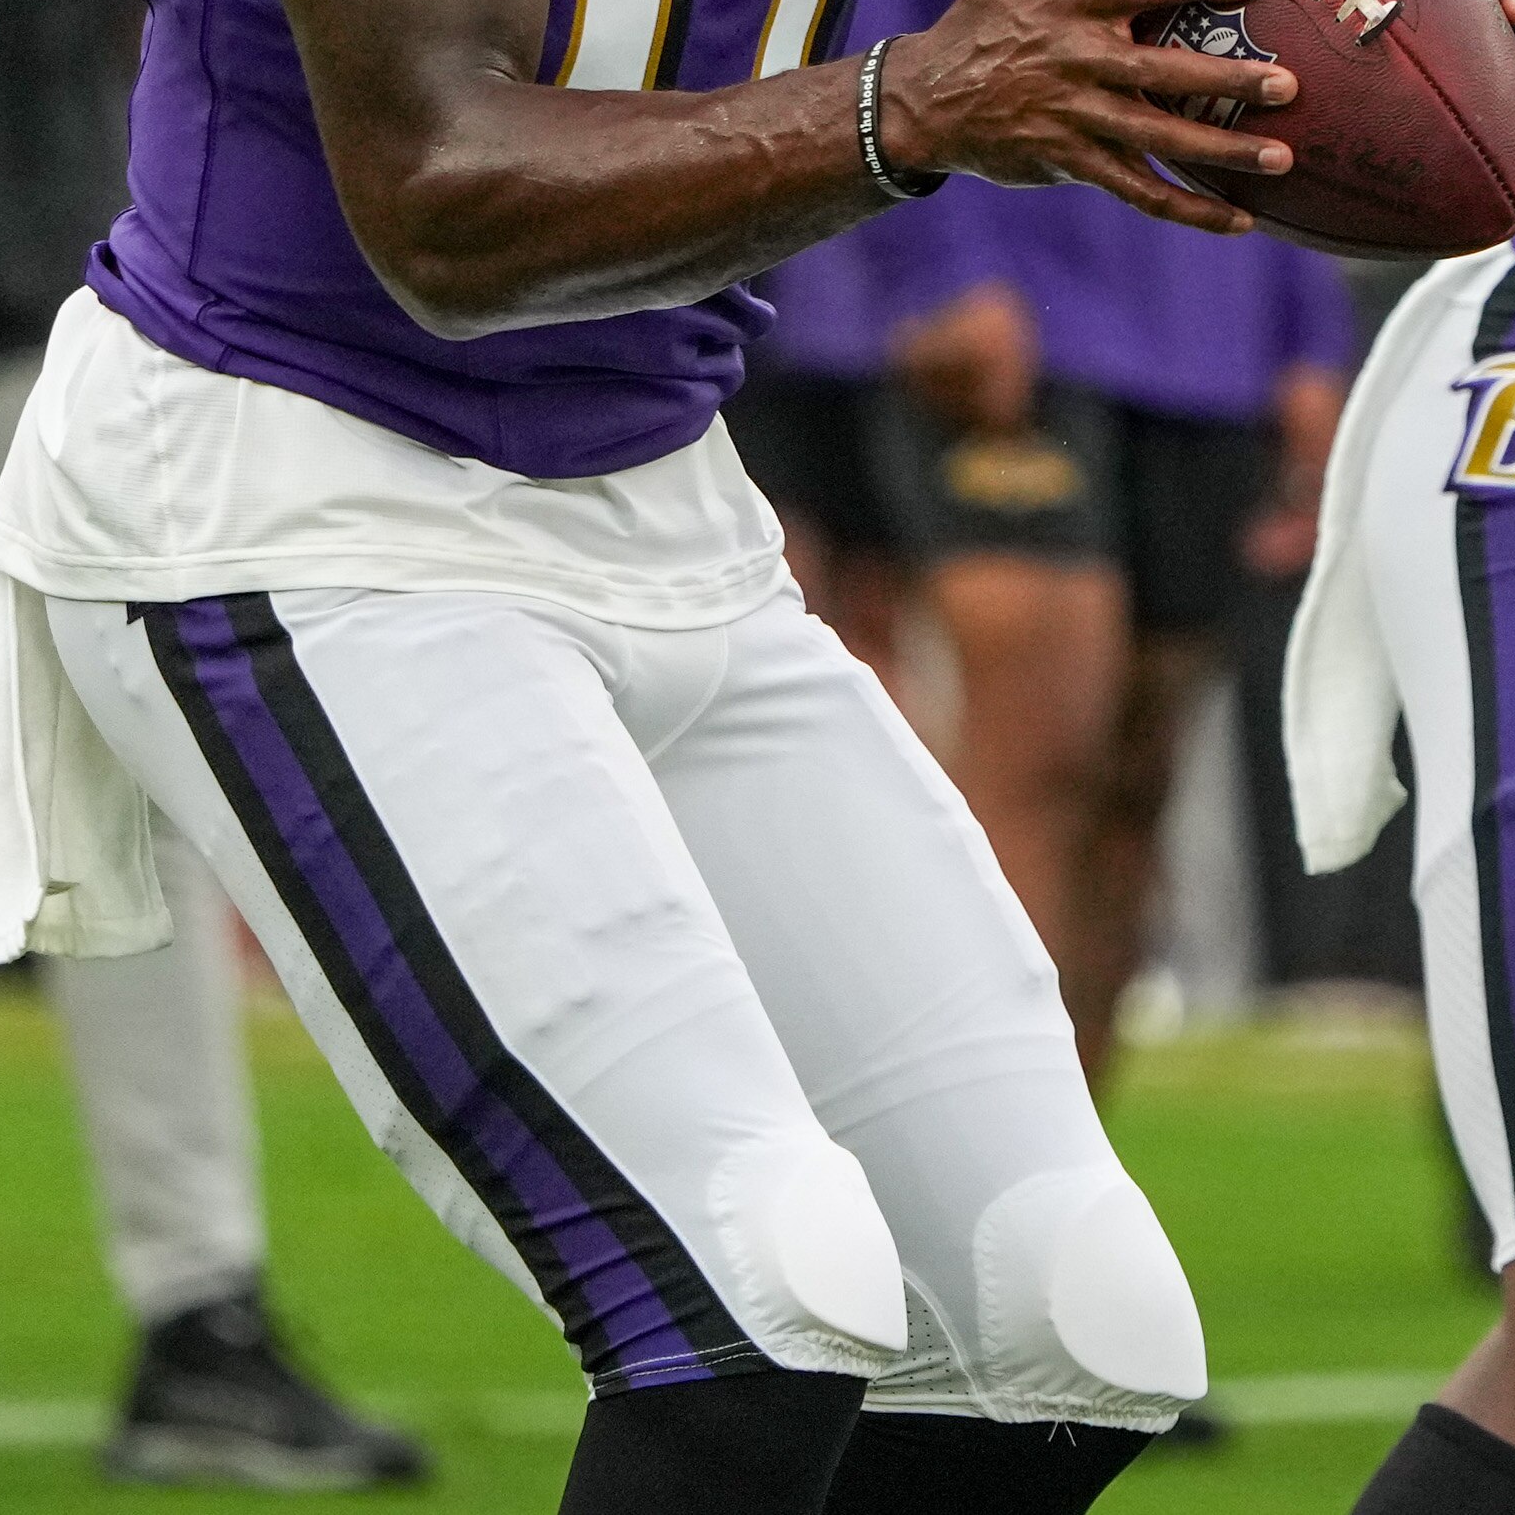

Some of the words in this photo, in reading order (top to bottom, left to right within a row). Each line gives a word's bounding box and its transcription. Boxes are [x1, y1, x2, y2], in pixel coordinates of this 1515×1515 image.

[864, 58, 878, 72] to
[859, 73, 875, 108] hood
[860, 110, 873, 134] the
